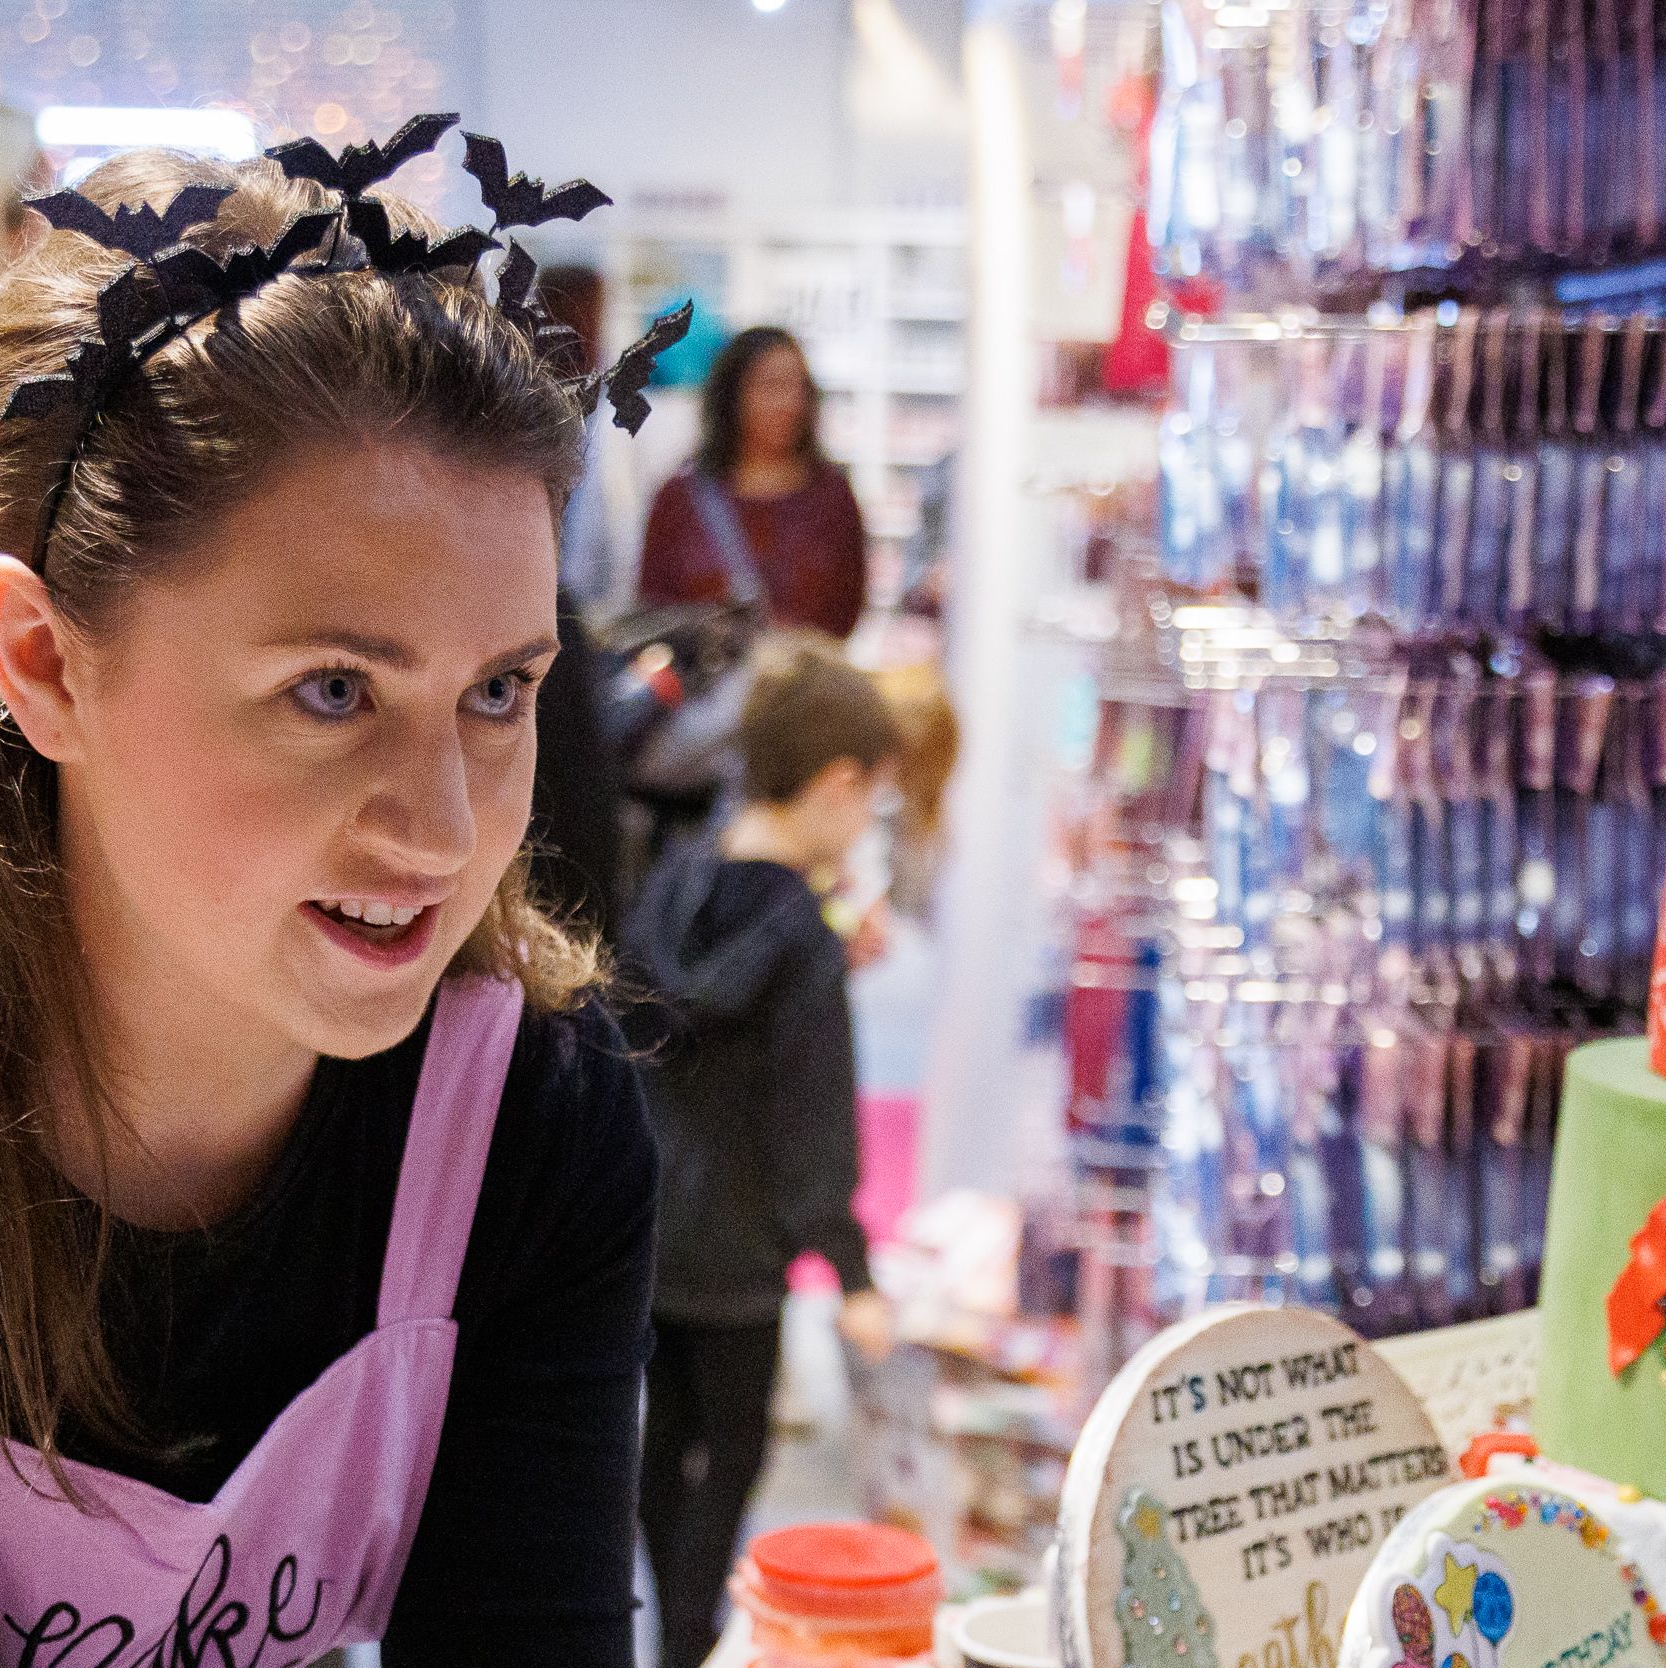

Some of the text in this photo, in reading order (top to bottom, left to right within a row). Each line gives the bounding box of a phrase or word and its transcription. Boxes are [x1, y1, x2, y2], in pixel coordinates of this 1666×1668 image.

[1216, 1363, 1276, 1407] NOT
[1280, 1342, 1359, 1390] WHAT
[1171, 1400, 1378, 1479] IS UNDER THE
[1170, 1446, 1451, 1543] TREE THAT MATTERS
[1304, 1513, 1373, 1557] WHO
